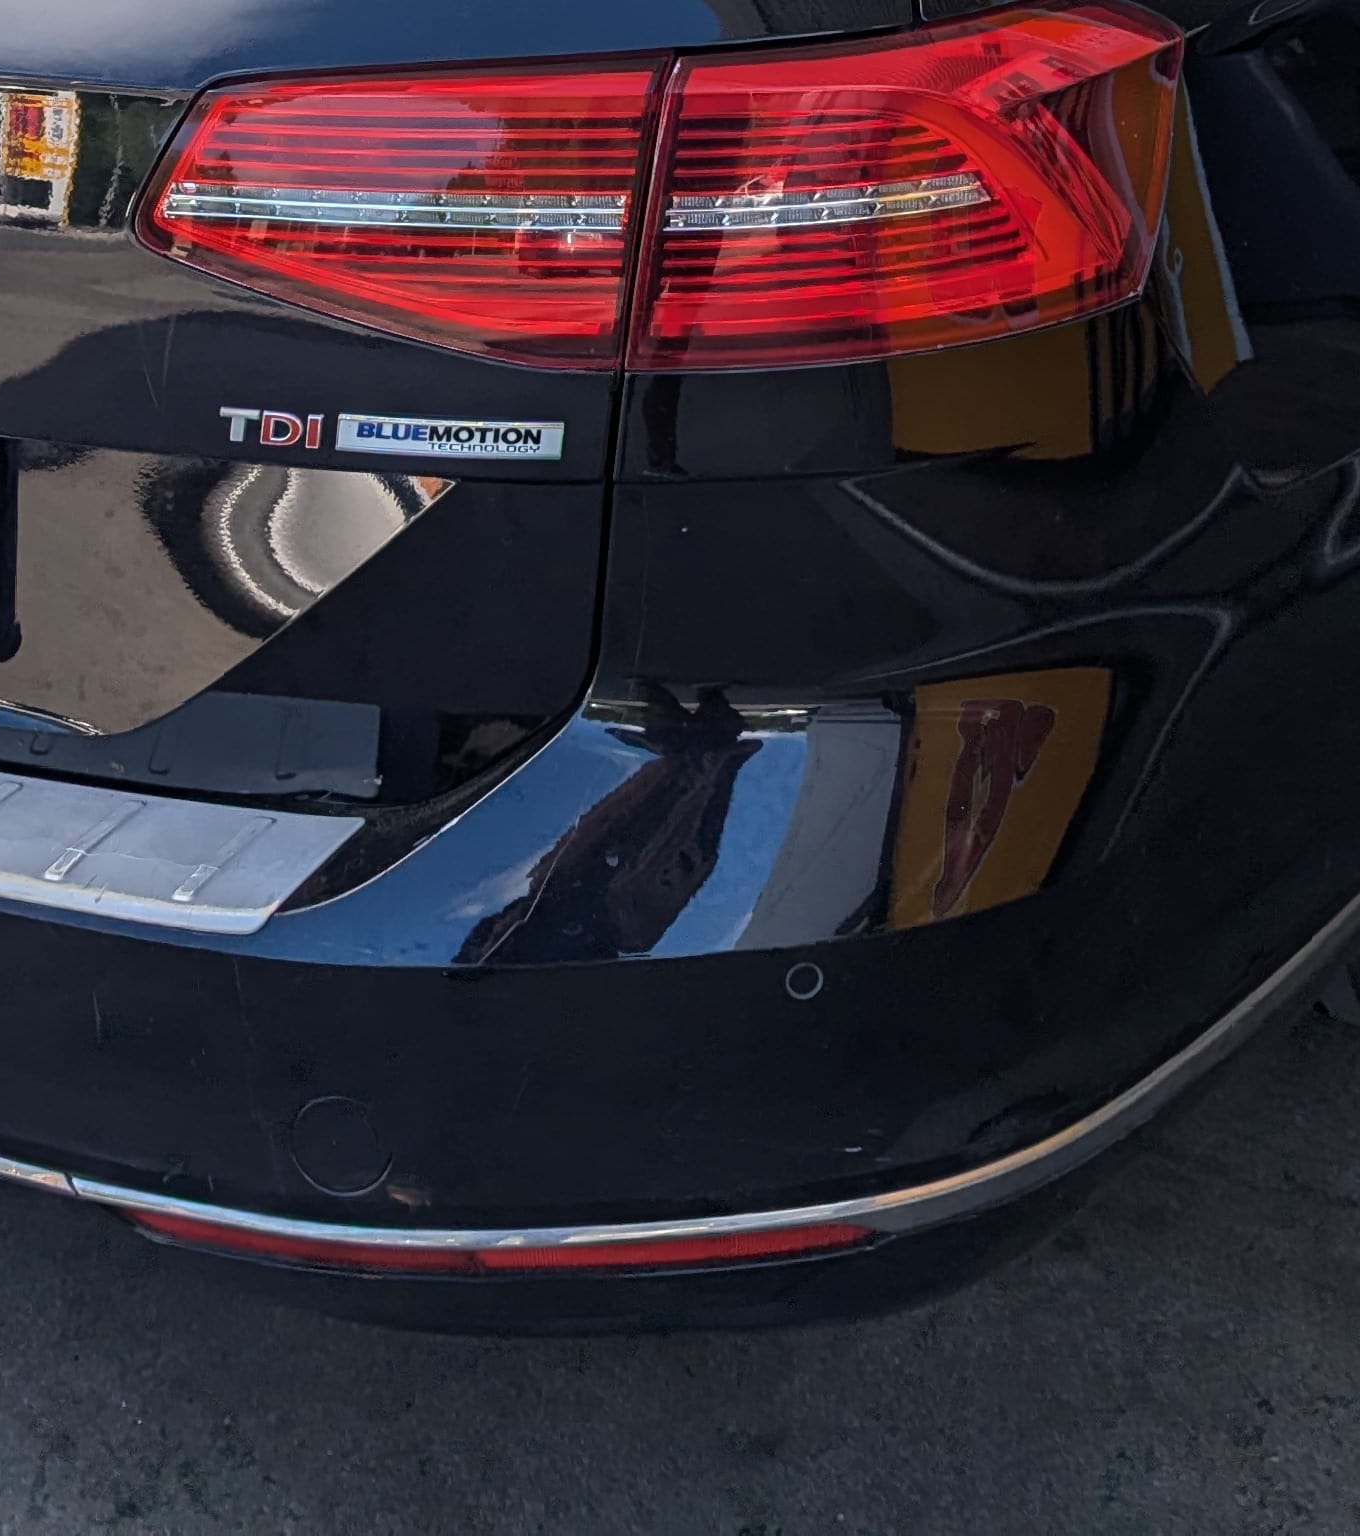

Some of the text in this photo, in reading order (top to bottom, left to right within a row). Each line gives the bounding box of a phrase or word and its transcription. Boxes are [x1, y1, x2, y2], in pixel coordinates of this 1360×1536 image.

[219, 406, 542, 450] TDI BLUEMOTION
[427, 441, 542, 455] TECHNOLOGY
